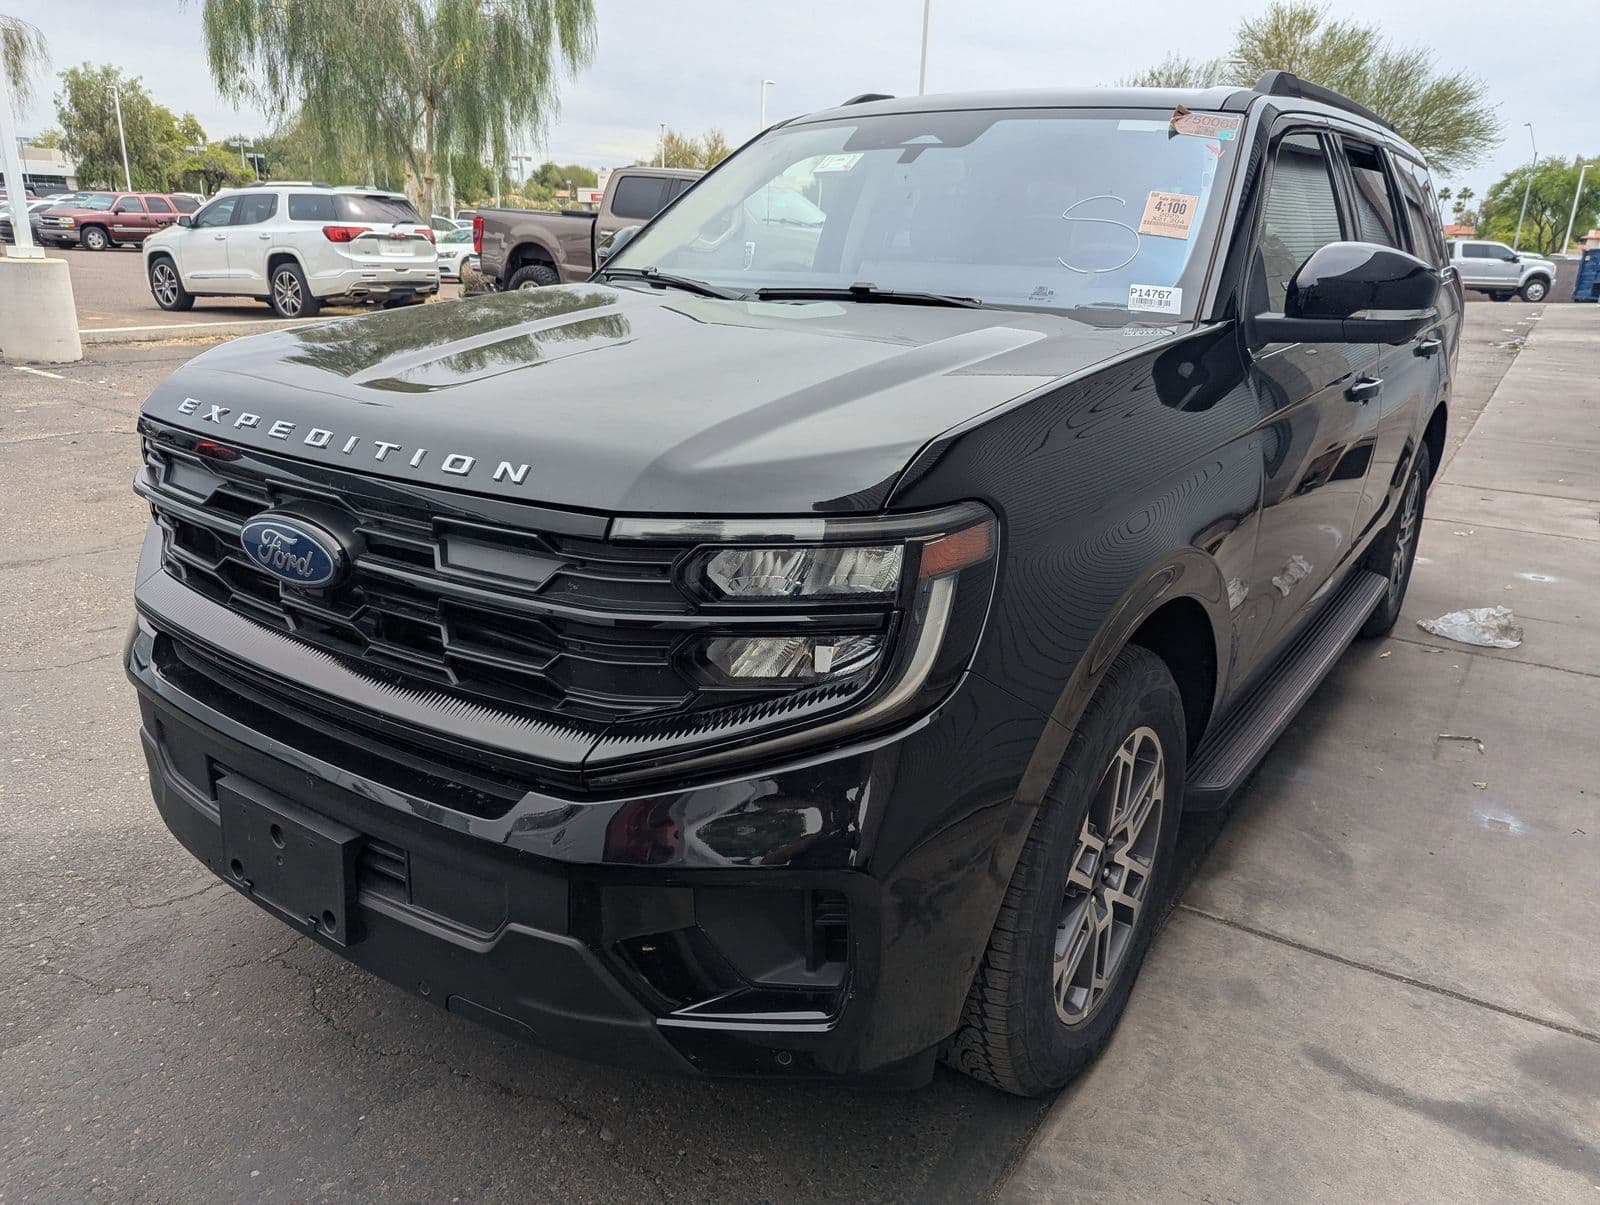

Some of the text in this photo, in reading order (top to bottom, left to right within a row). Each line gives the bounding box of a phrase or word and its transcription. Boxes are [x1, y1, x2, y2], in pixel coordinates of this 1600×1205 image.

[1154, 200, 1187, 215] 4:100
[1130, 288, 1172, 299] P14767
[177, 396, 532, 485] EXPEDITION
[257, 528, 314, 578] Ford
